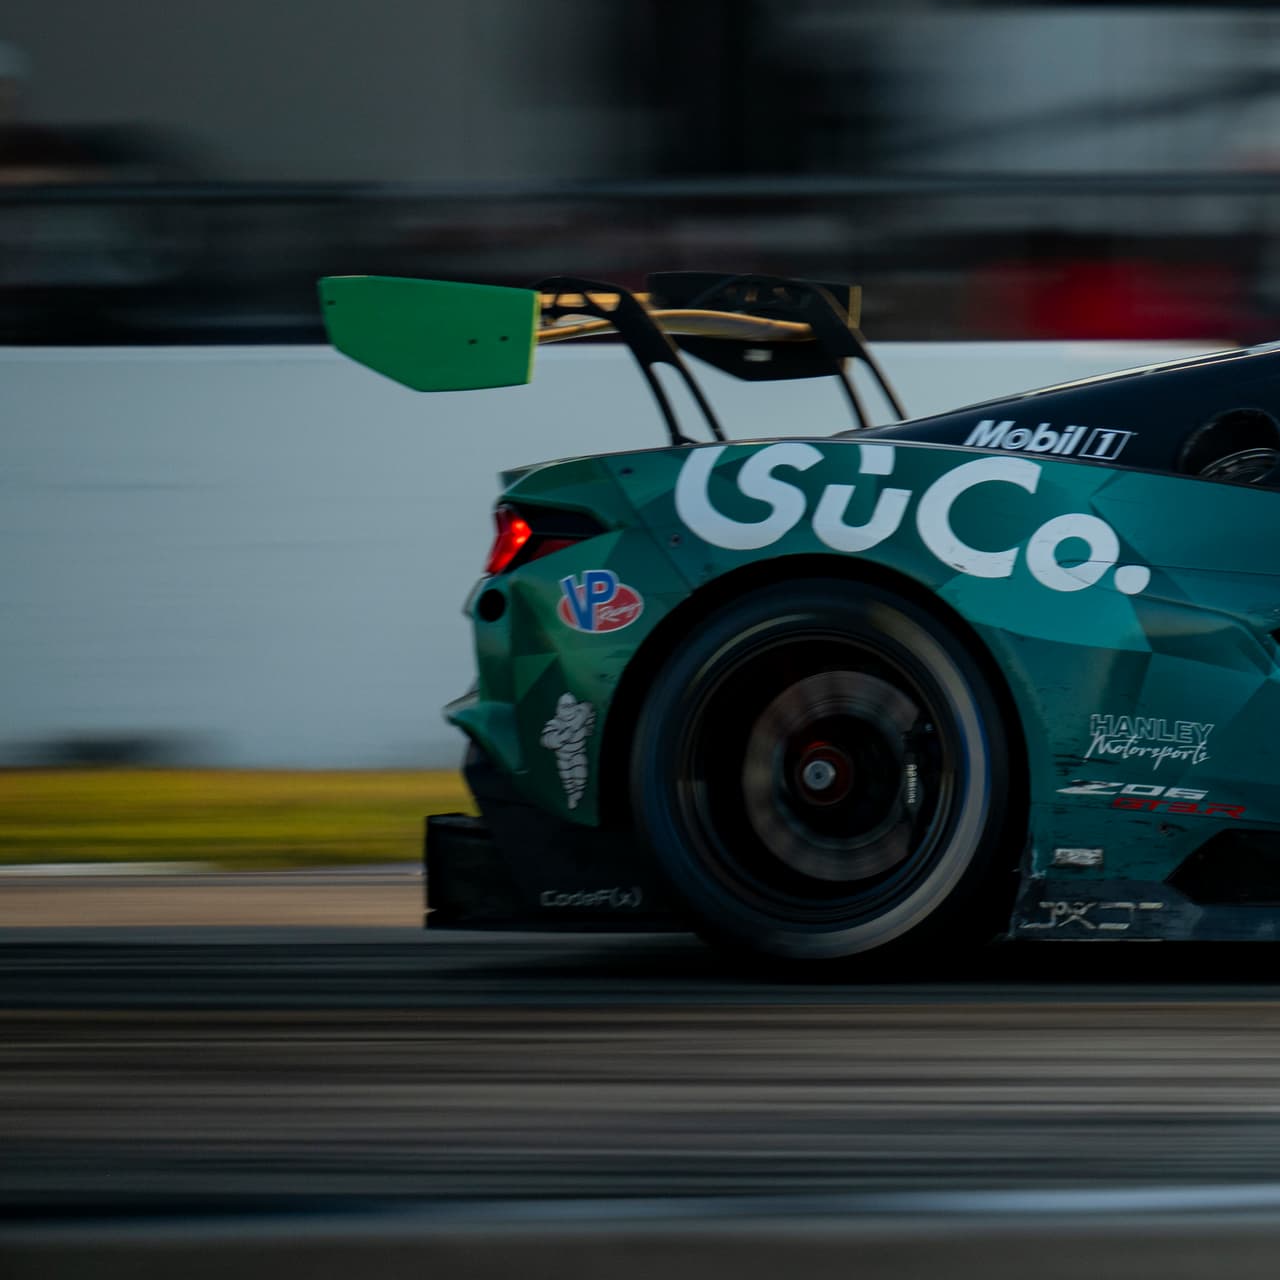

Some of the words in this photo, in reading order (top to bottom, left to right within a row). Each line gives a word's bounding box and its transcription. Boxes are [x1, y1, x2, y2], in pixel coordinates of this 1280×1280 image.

[963, 420, 1089, 456] Mobil
[559, 570, 620, 632] VP
[1089, 714, 1216, 744] HANLEY
[1082, 733, 1212, 771] Motorsports
